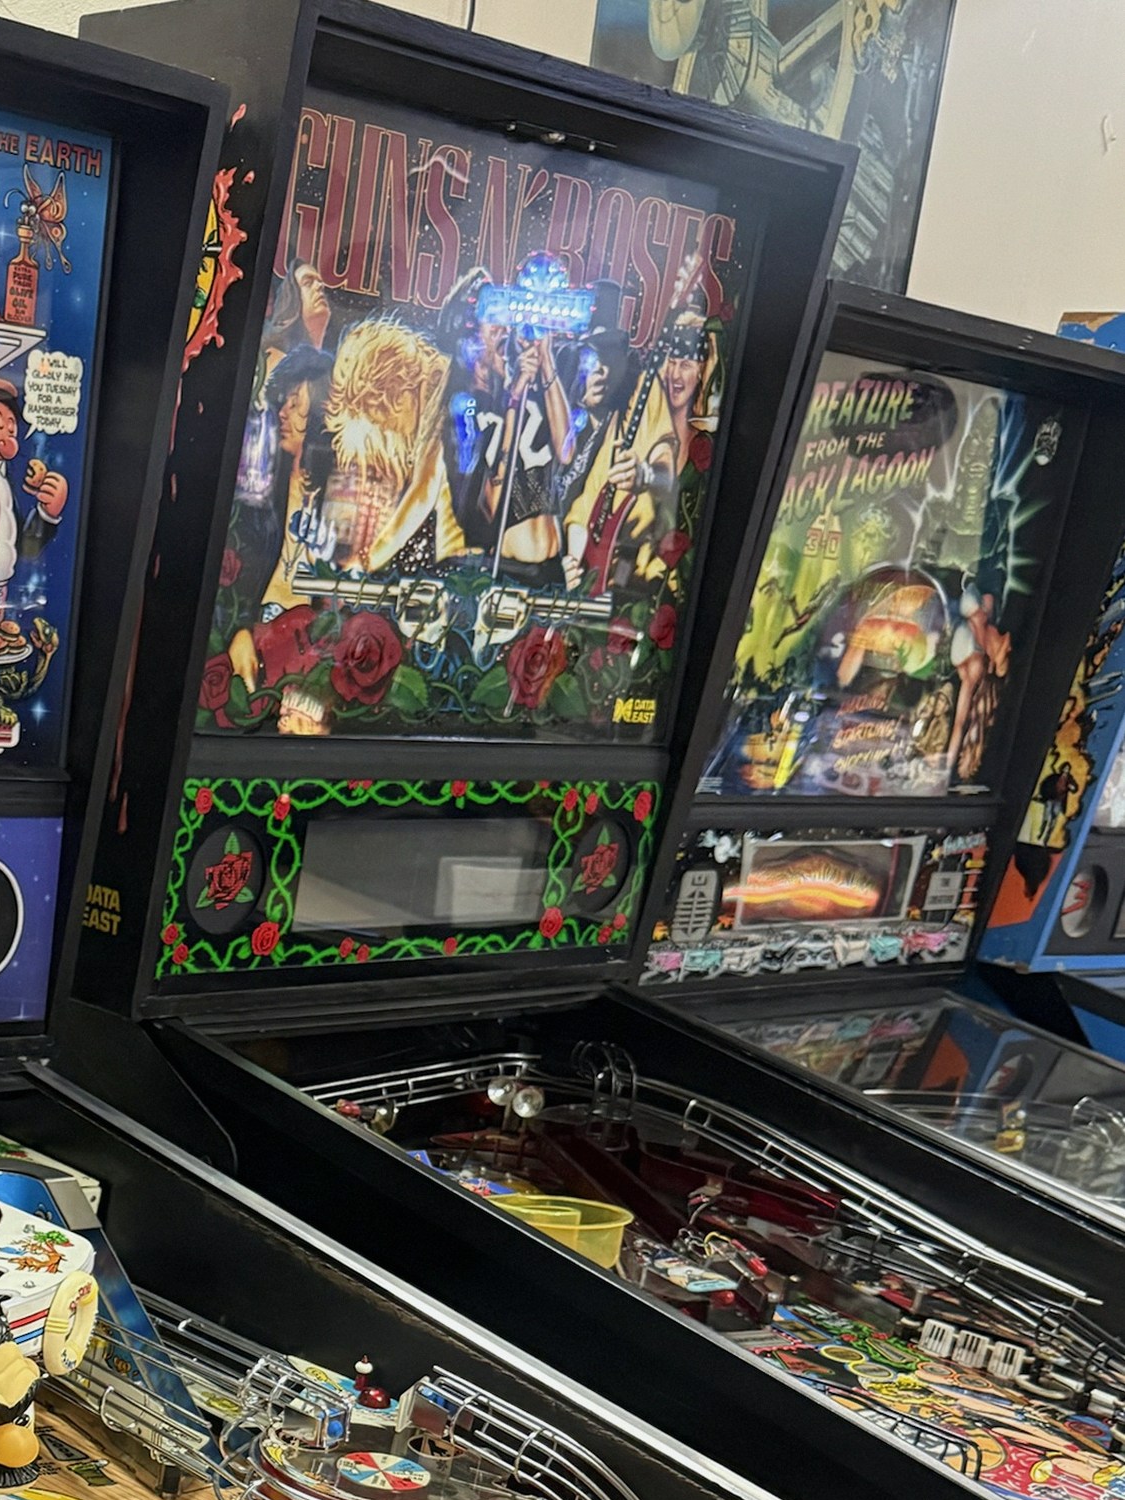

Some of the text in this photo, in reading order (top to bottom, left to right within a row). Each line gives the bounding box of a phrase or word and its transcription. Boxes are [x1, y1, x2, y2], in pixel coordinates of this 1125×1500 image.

[25, 133, 103, 178] EARTH
[272, 106, 472, 310] GUNS
[479, 155, 553, 284] N'
[64, 373, 79, 383] PAY
[28, 381, 79, 398] YOU TUESDAY
[37, 393, 63, 405] FOR A
[27, 403, 77, 418] HAMBURGER
[802, 431, 887, 470] FROM THE
[831, 446, 937, 514] LAGOON
[634, 698, 656, 710] DATA
[632, 711, 655, 724] EAST
